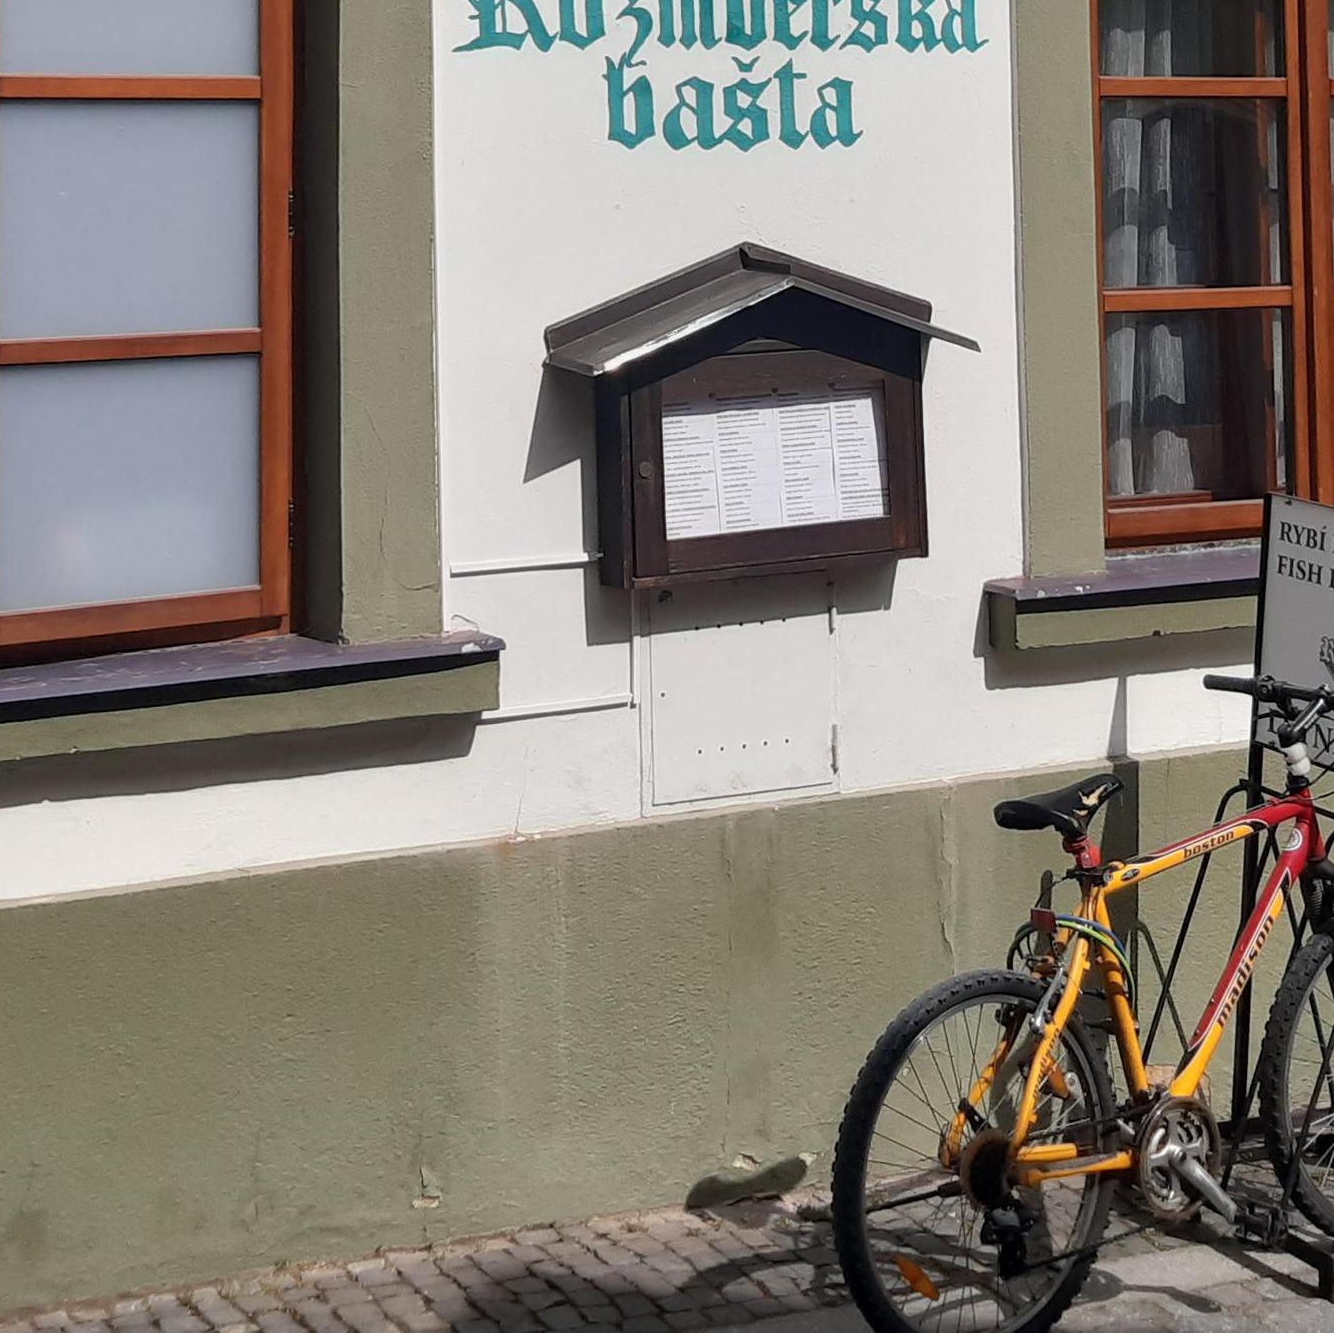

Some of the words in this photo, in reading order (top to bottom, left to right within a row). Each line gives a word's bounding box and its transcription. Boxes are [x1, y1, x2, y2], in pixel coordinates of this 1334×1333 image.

[602, 53, 863, 153] bašta
[1279, 520, 1328, 552] RYBÍ
[1276, 554, 1322, 586] FISH
[1183, 830, 1236, 860] boston
[1217, 914, 1275, 1029] madison
